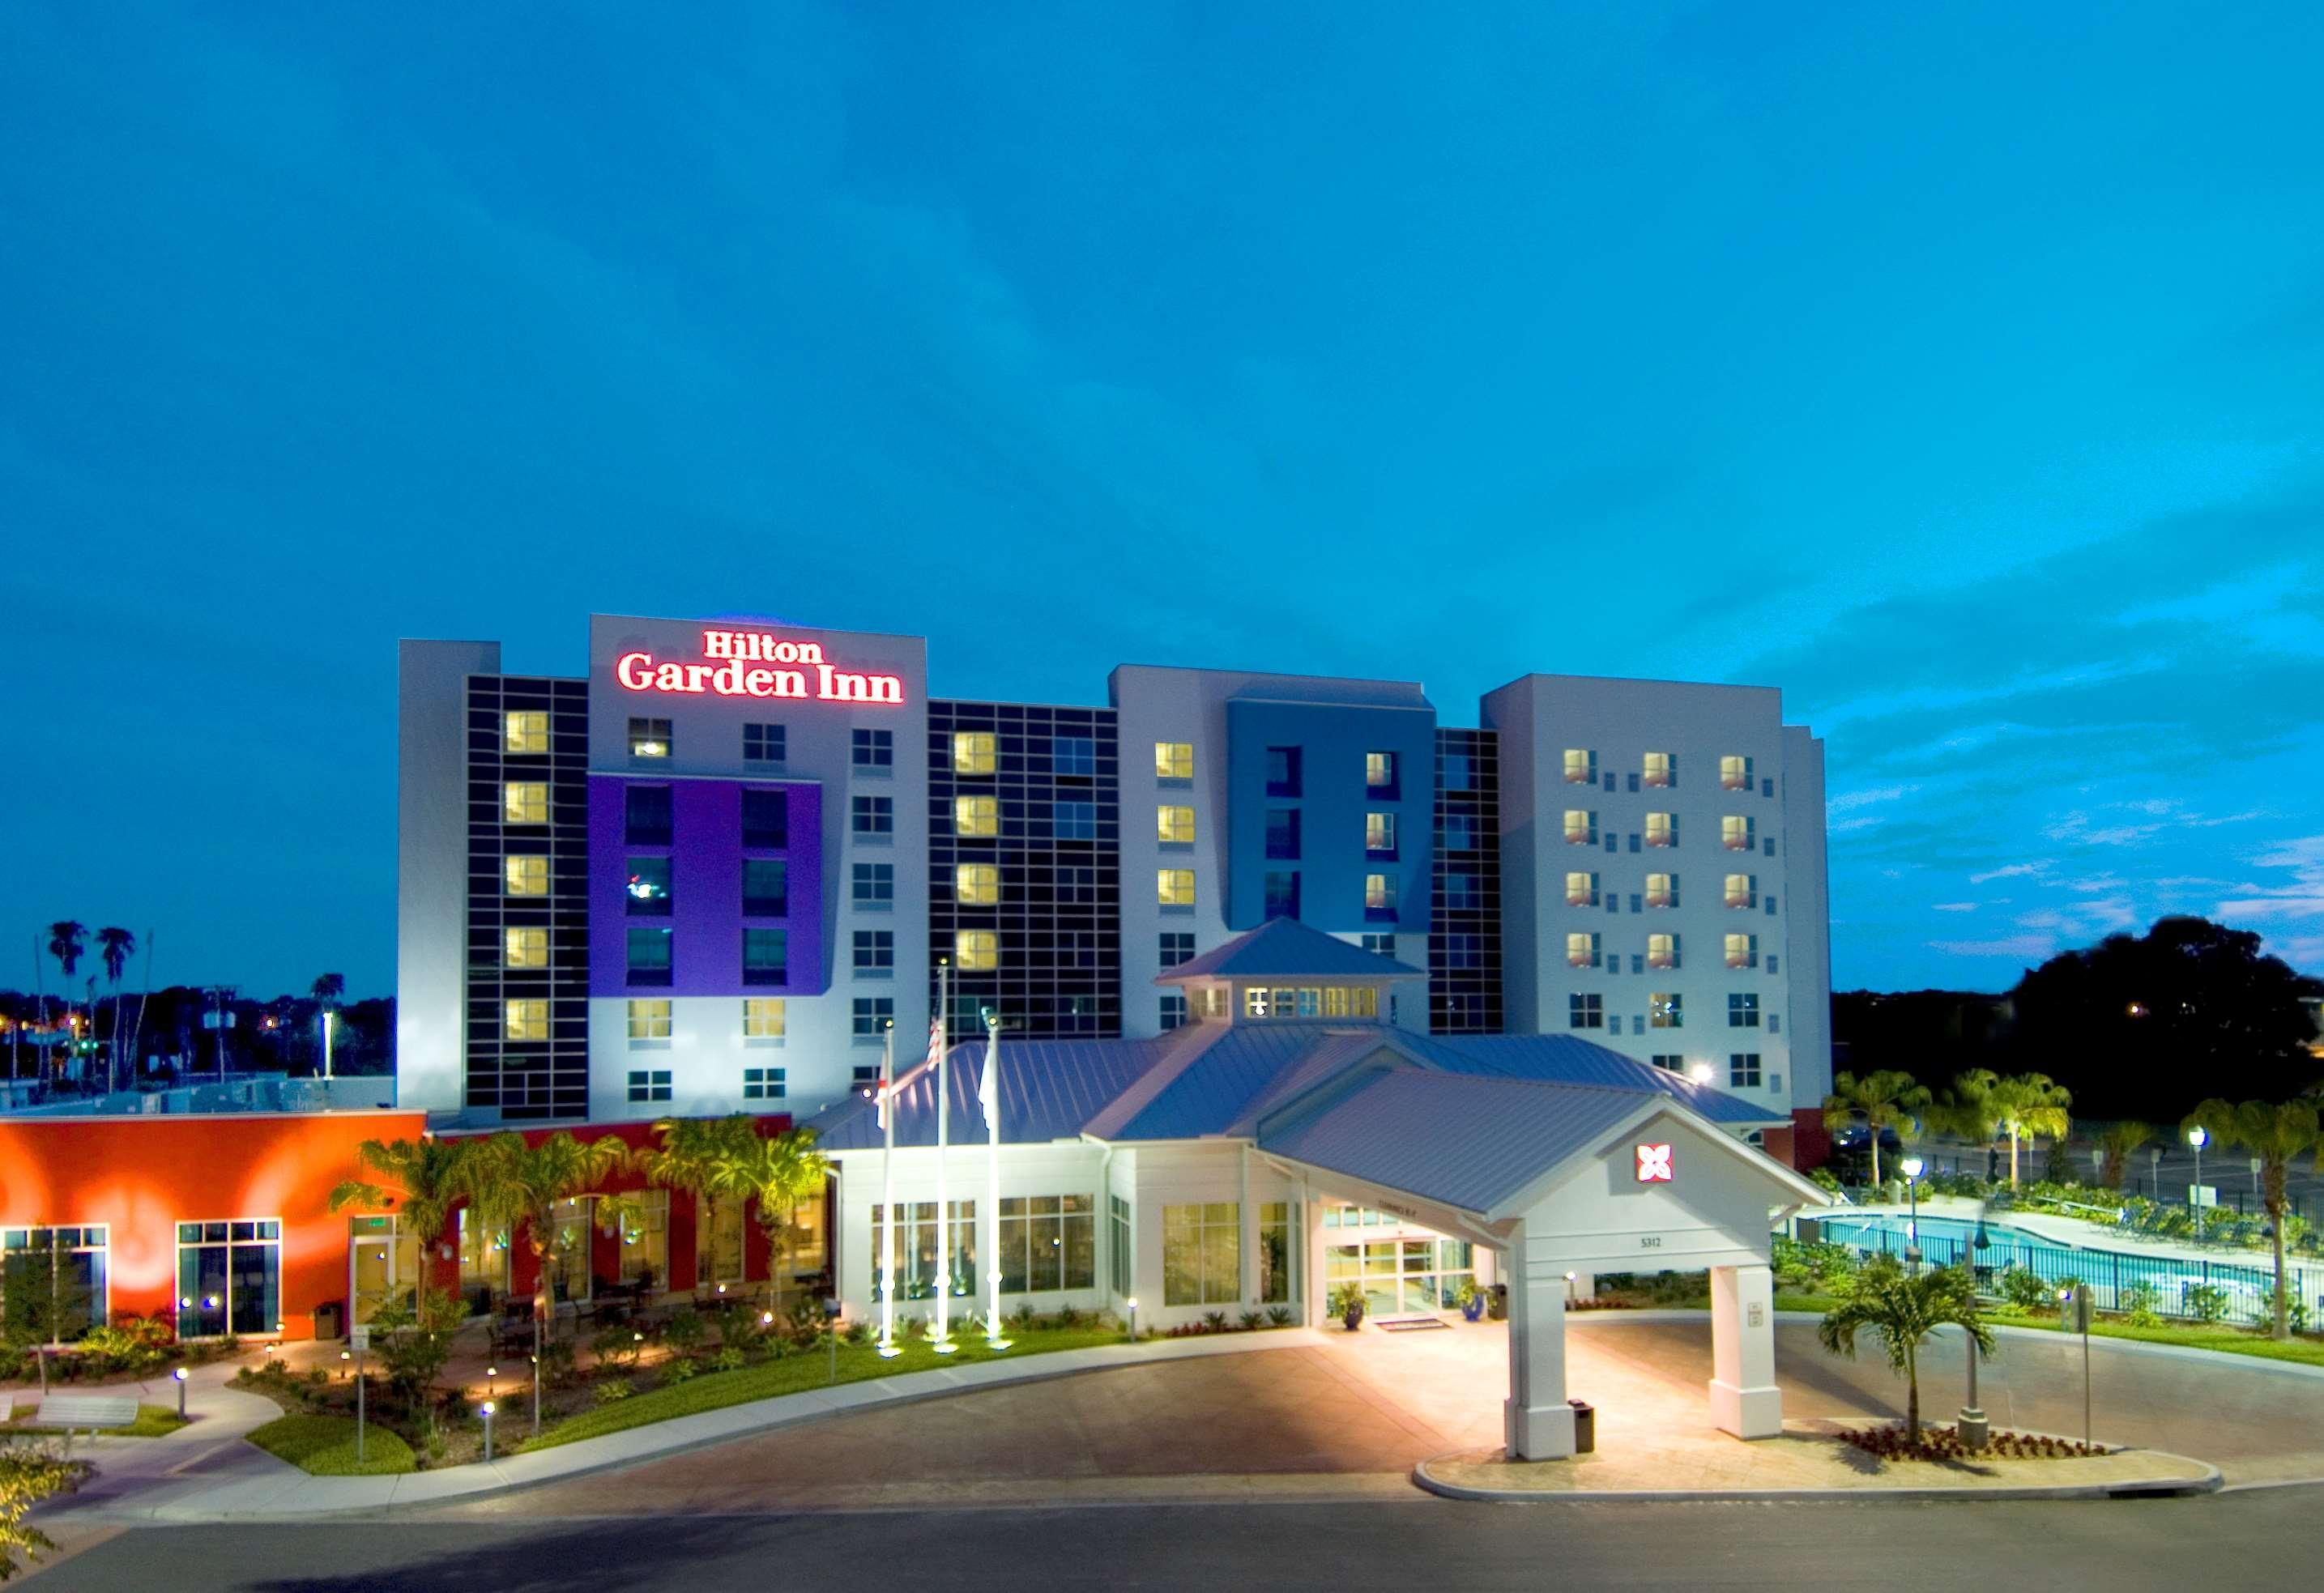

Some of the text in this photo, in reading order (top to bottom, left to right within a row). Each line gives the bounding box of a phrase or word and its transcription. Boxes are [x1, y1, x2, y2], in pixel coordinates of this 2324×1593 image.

[703, 631, 824, 664] Hilton
[617, 653, 903, 703] Garden Inn
[1641, 1237, 1661, 1247] 5312
